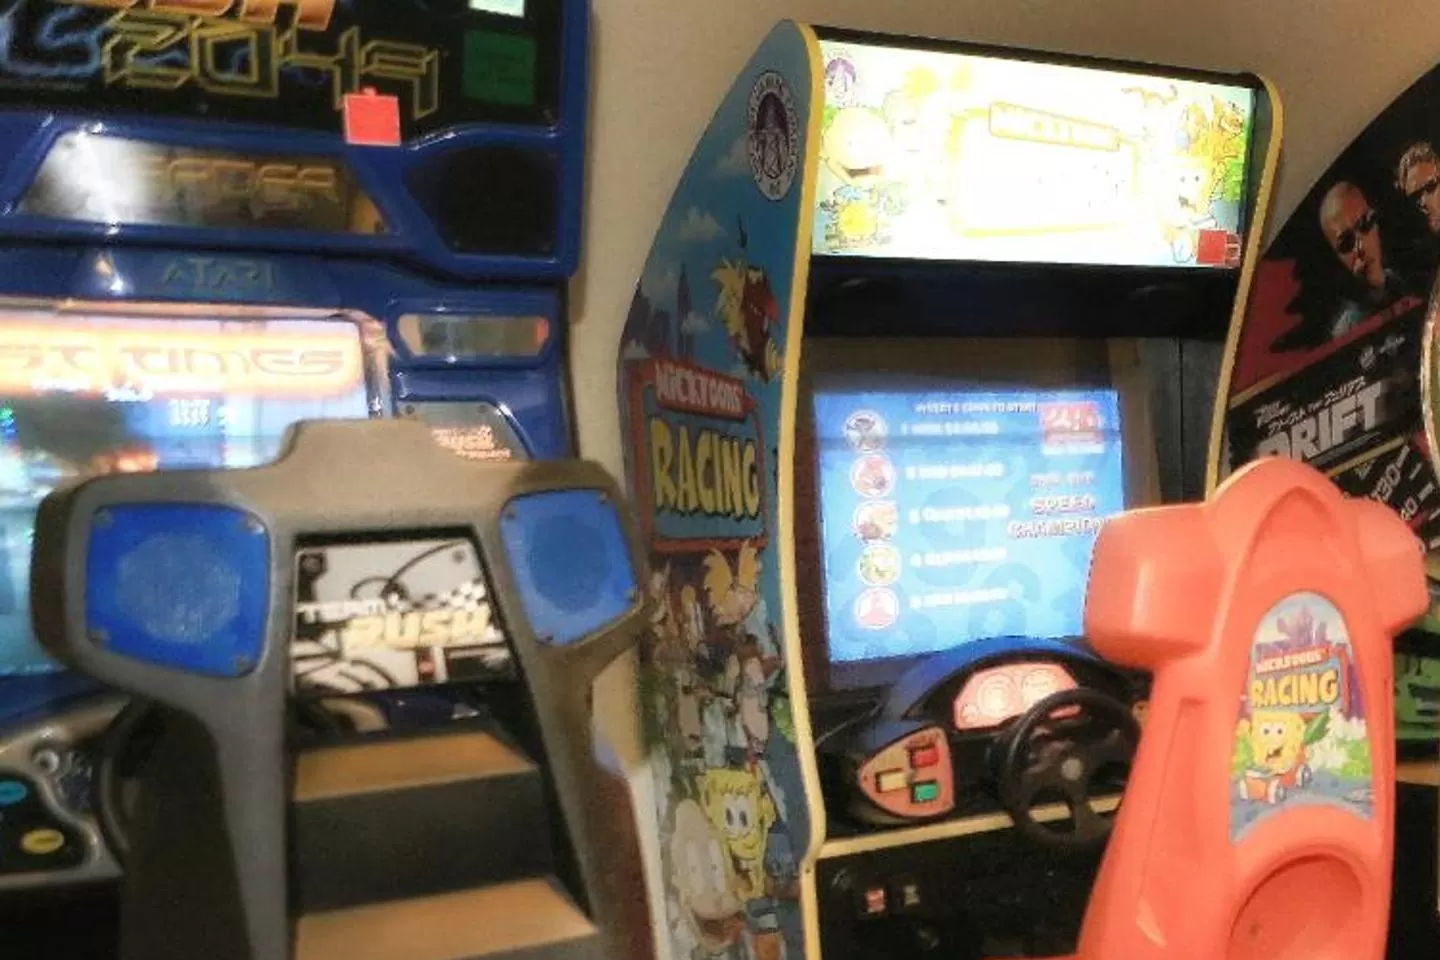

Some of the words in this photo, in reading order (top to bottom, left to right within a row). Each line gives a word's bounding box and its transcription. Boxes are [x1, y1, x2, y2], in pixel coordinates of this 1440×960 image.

[1257, 382, 1381, 460] DRIFT
[651, 417, 760, 519] RACING
[341, 603, 492, 650] RUSH
[1251, 669, 1338, 707] RACING
